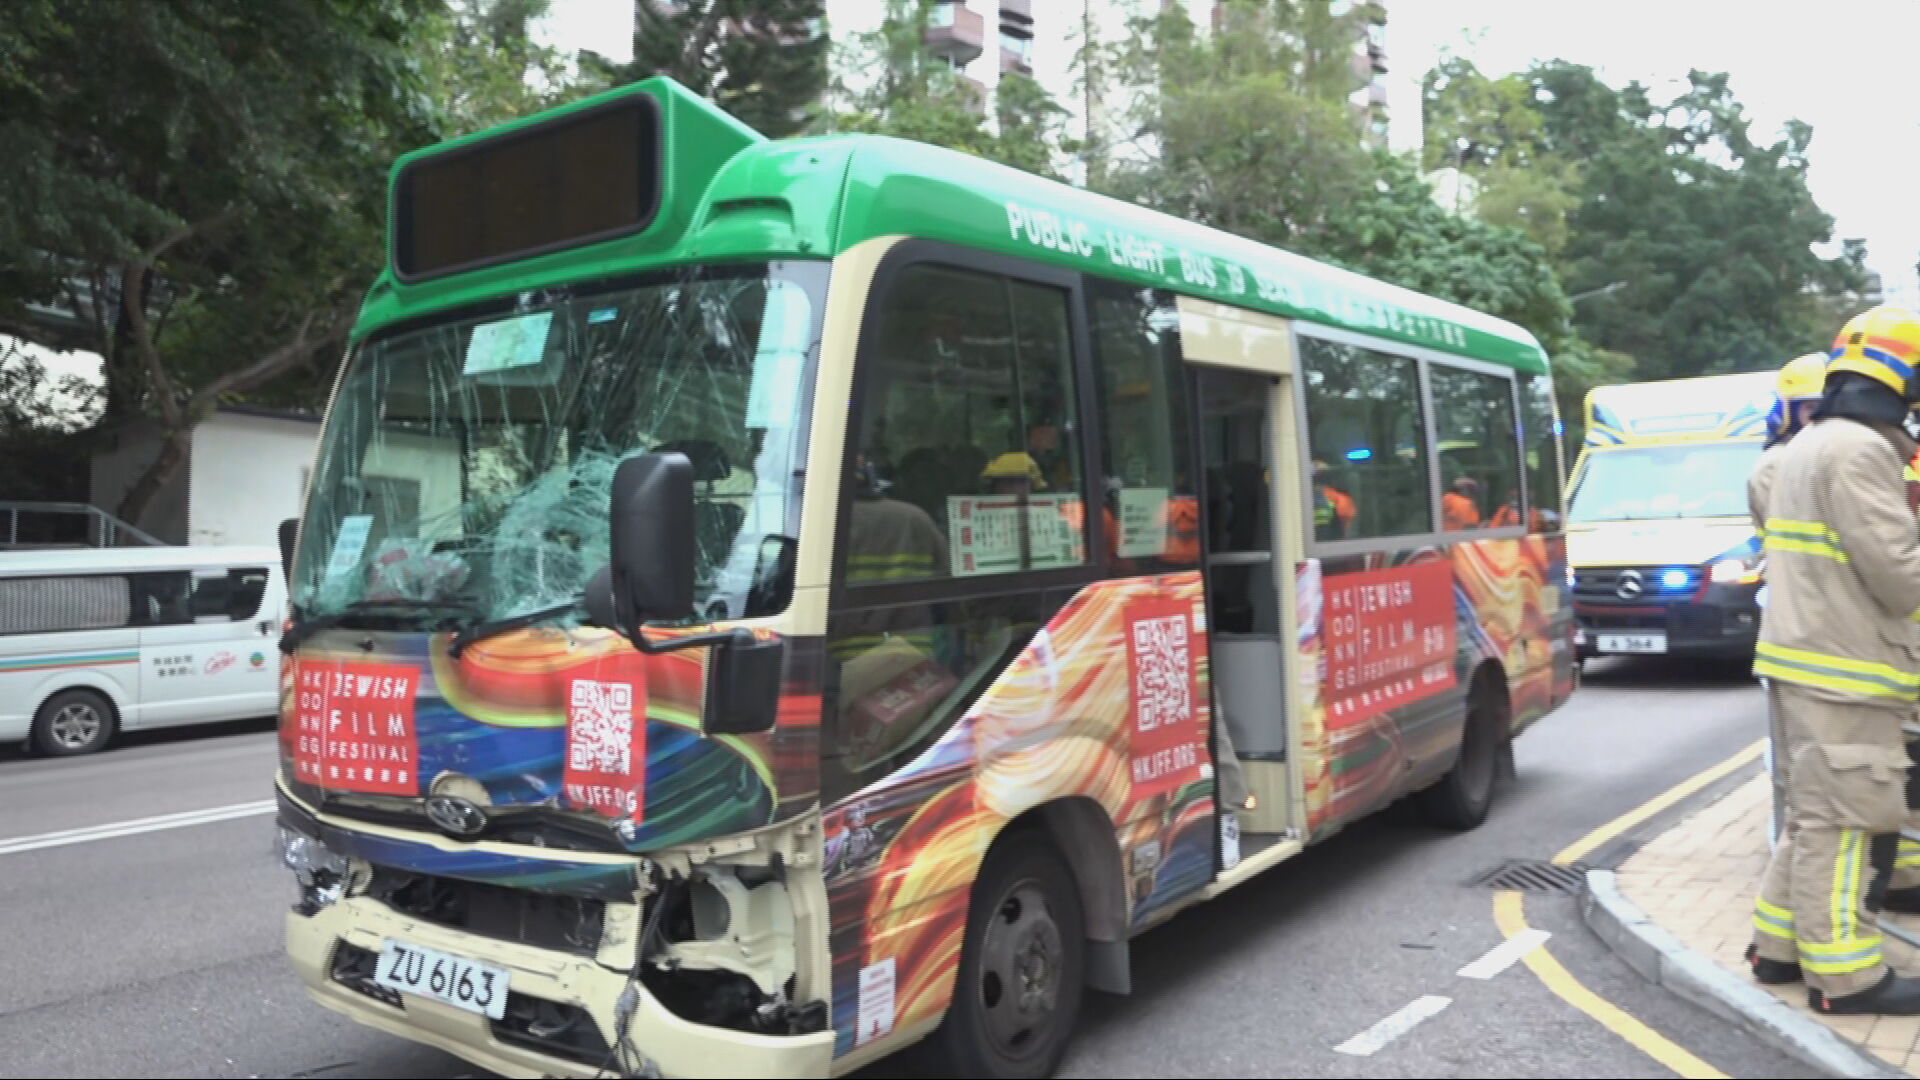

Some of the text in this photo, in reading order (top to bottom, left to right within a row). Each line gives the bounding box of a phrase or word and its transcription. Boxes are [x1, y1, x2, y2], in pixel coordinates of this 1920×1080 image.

[1006, 202, 1093, 258] PUBLIC
[1106, 229, 1166, 275] LIGHT
[1179, 250, 1217, 288] BUS
[1360, 580, 1413, 613] JEWISH
[1363, 619, 1415, 653] FILM
[332, 672, 409, 699] JEWISH
[330, 709, 406, 737] FILM
[329, 741, 409, 763] FESTIVAL
[388, 945, 495, 1006] ZU 6163
